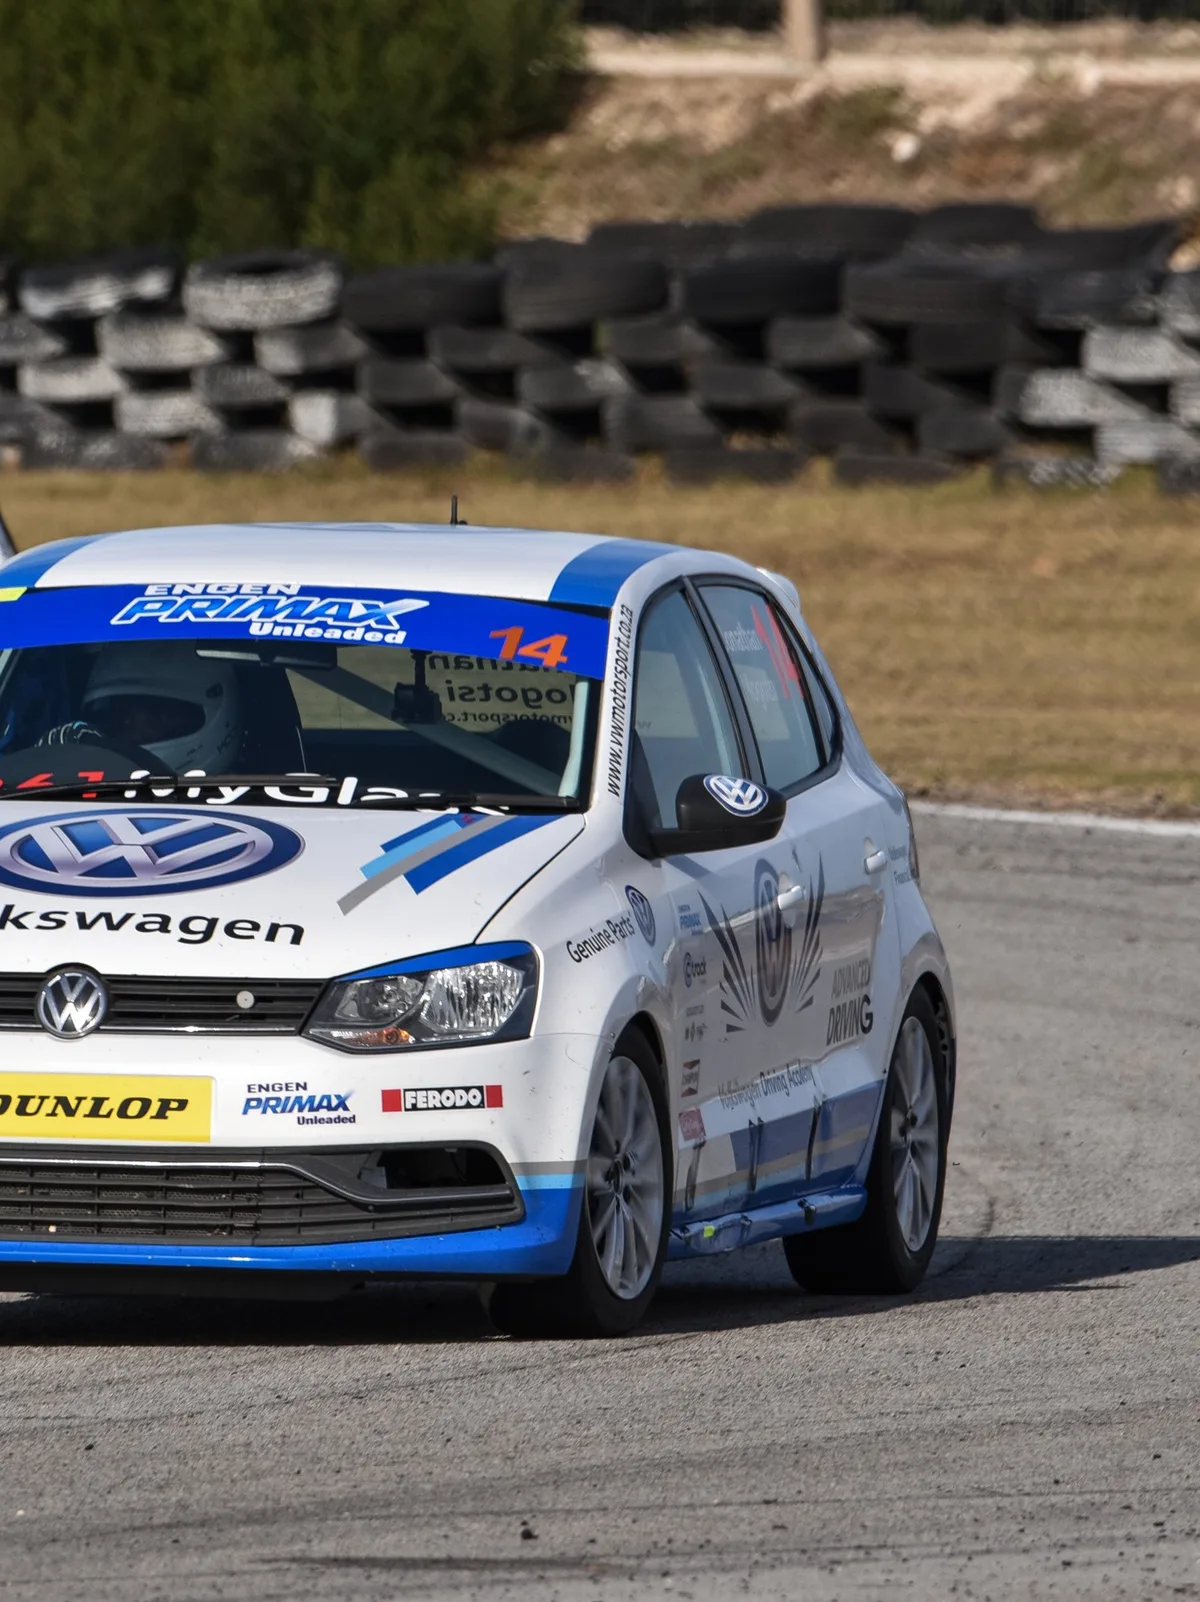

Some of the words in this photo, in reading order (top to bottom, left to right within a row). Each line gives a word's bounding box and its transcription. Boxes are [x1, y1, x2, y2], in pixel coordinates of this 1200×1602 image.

[144, 583, 302, 596] ENGEN
[110, 595, 430, 629] PRIMAX
[248, 622, 406, 645] Unleaded
[489, 625, 568, 668] 14
[607, 604, 634, 798] www.vwmotorsport.co.za
[566, 928, 616, 964] Genuine
[826, 994, 874, 1046] DRIVING
[247, 1082, 308, 1094] ENGEN
[404, 1088, 483, 1110] FERODO
[241, 1090, 356, 1115] PRIMAX
[297, 1114, 356, 1125] Unleaded
